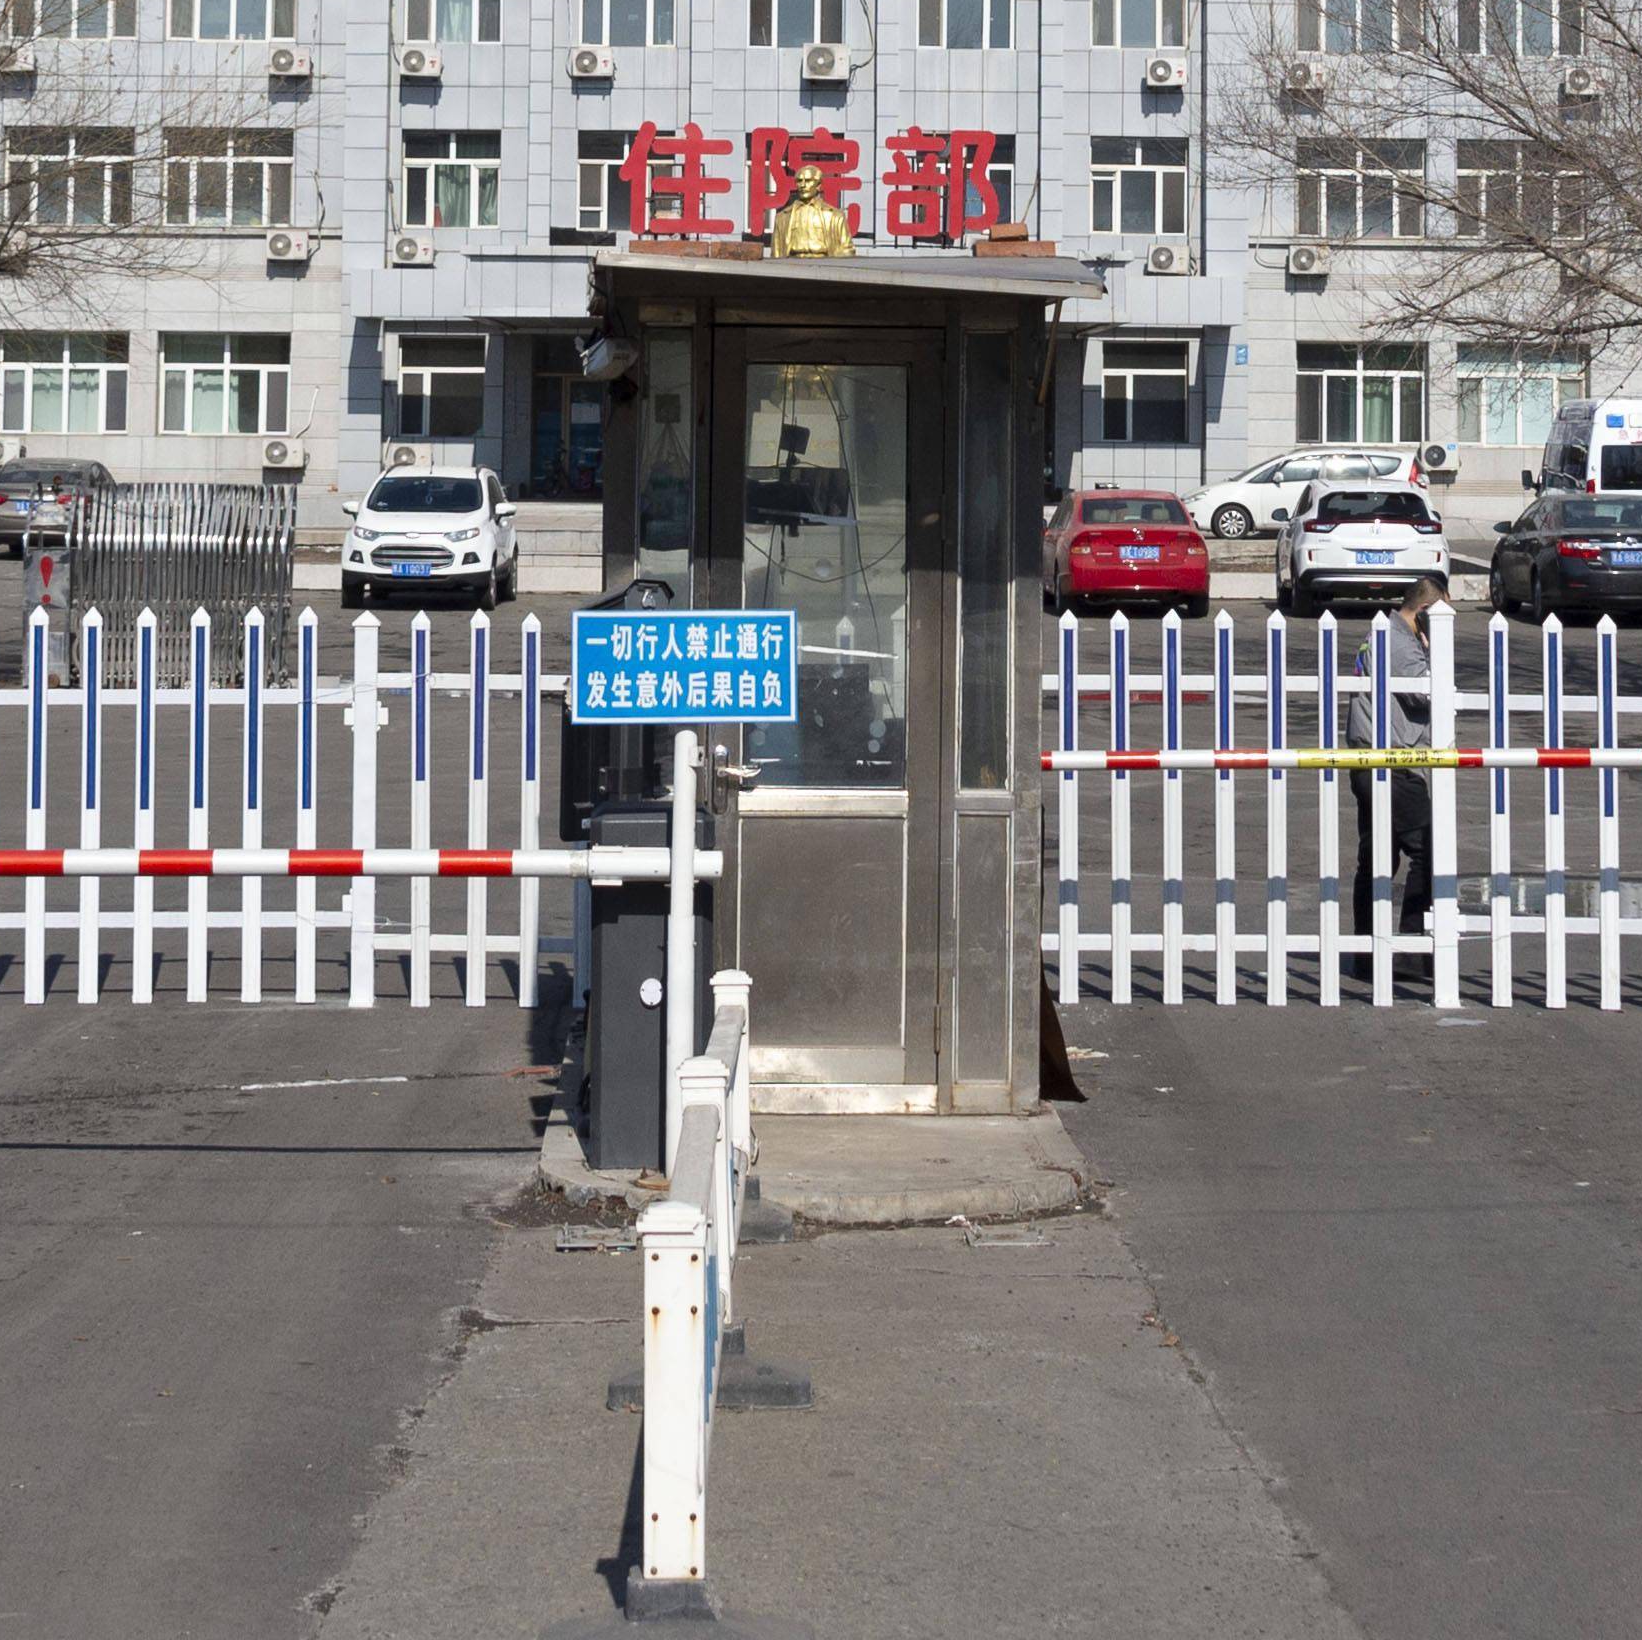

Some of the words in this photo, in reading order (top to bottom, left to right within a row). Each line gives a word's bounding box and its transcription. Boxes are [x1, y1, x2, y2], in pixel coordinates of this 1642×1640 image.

[618, 120, 1000, 240] 住院部
[585, 623, 784, 661] 一切行人禁止通行
[585, 669, 783, 709] 发生意外后果自负
